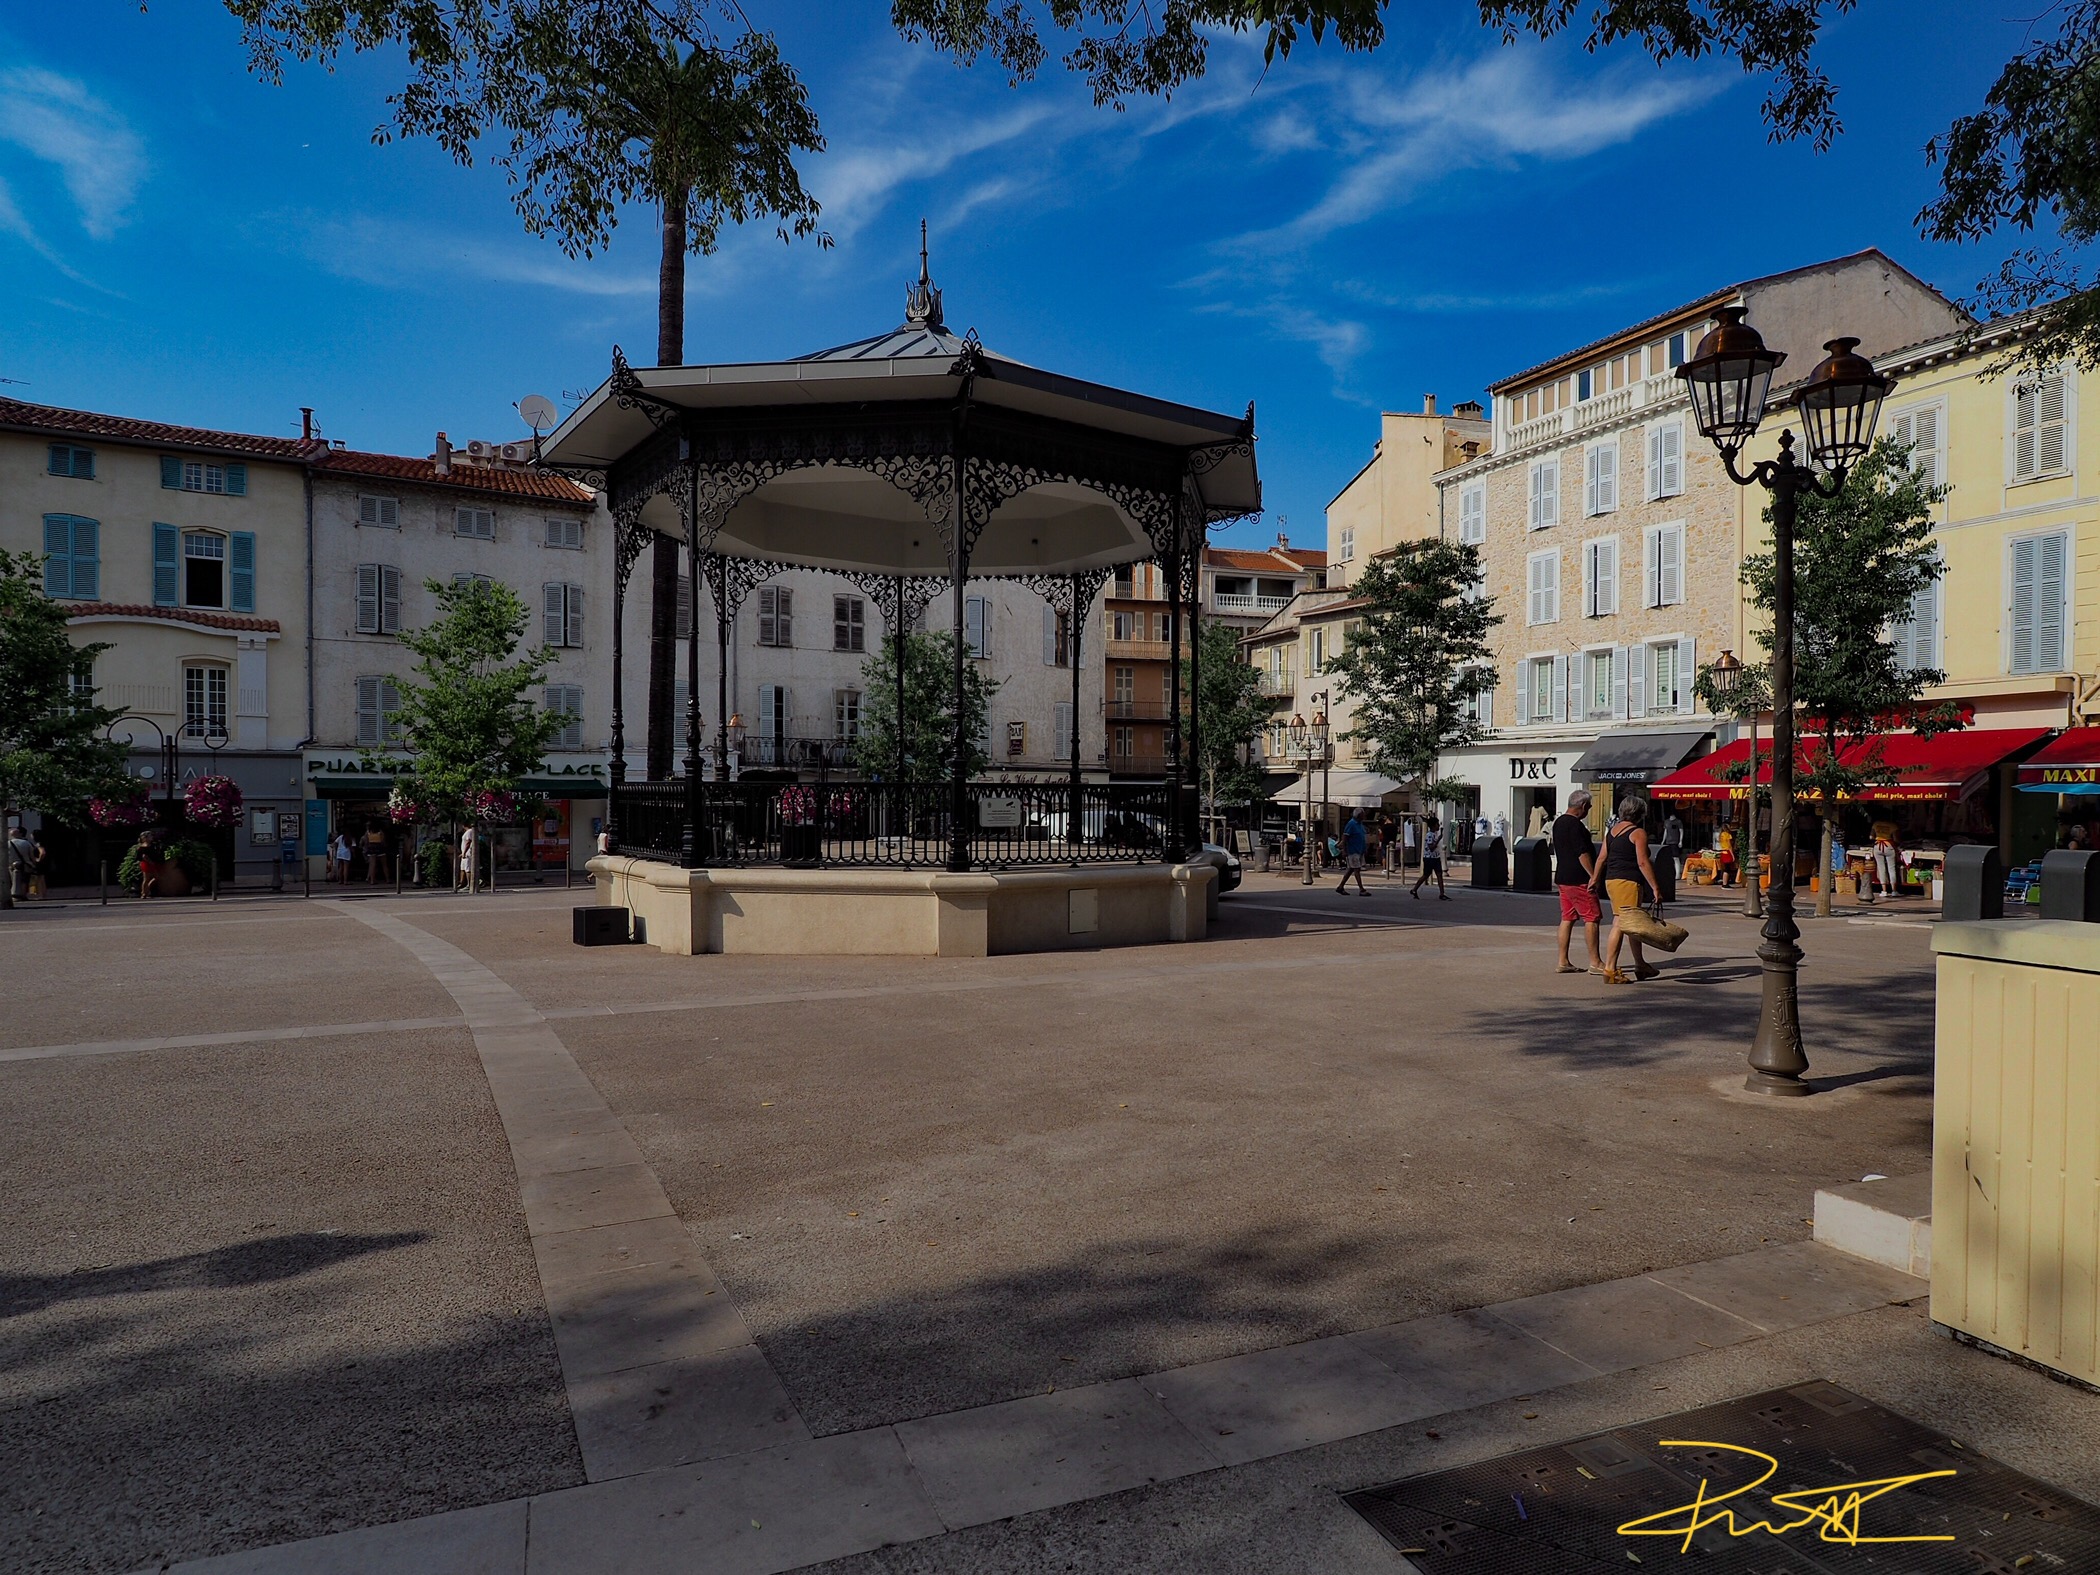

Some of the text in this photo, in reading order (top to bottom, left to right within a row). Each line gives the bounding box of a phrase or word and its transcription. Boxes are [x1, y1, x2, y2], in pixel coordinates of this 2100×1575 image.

[527, 764, 606, 776] PLACE
[1510, 757, 1556, 779] D & C
[2043, 769, 2096, 782] MAXI
